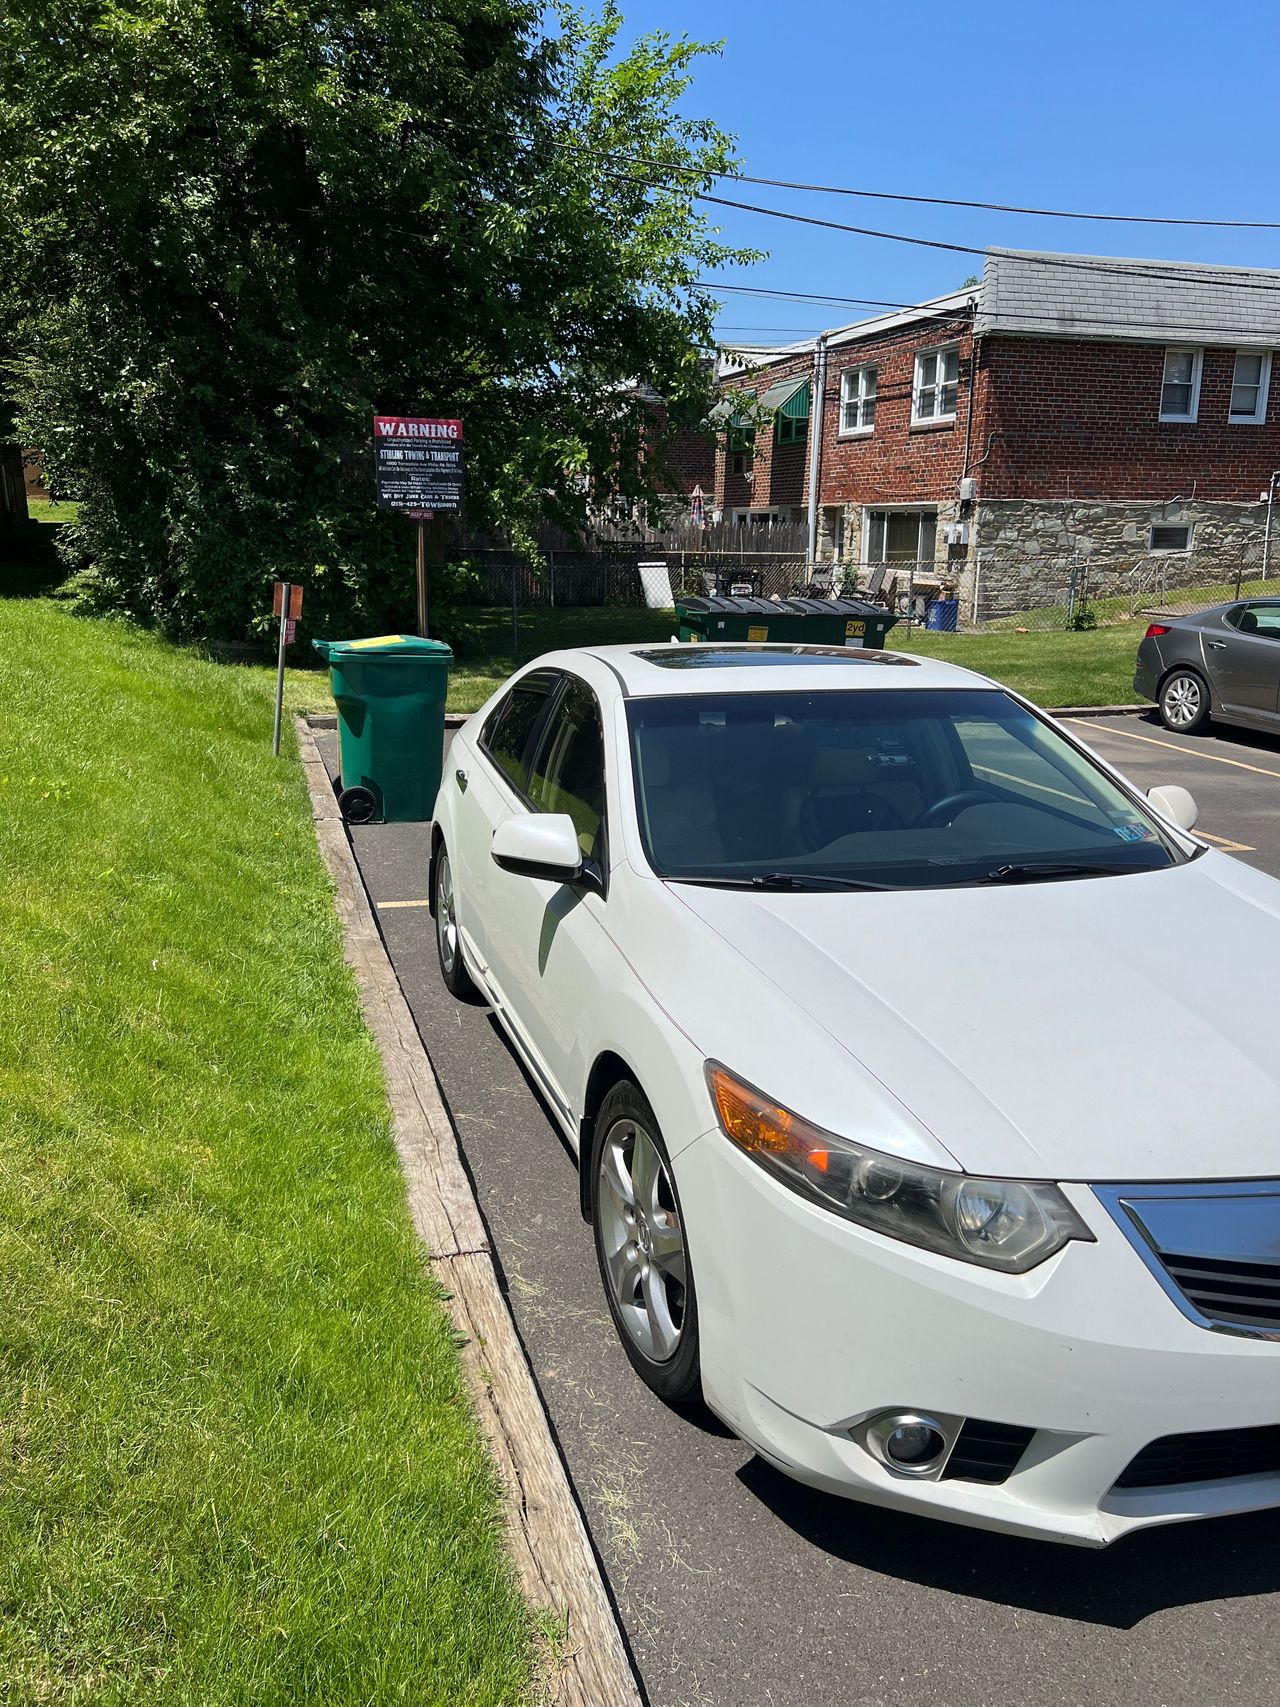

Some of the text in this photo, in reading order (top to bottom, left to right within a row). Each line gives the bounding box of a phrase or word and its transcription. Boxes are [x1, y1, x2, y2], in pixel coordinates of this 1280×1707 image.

[378, 422, 459, 438] WARNING
[380, 450, 460, 462] STIRLING TOWING & TRANSPORT
[848, 622, 864, 634] 2yd
